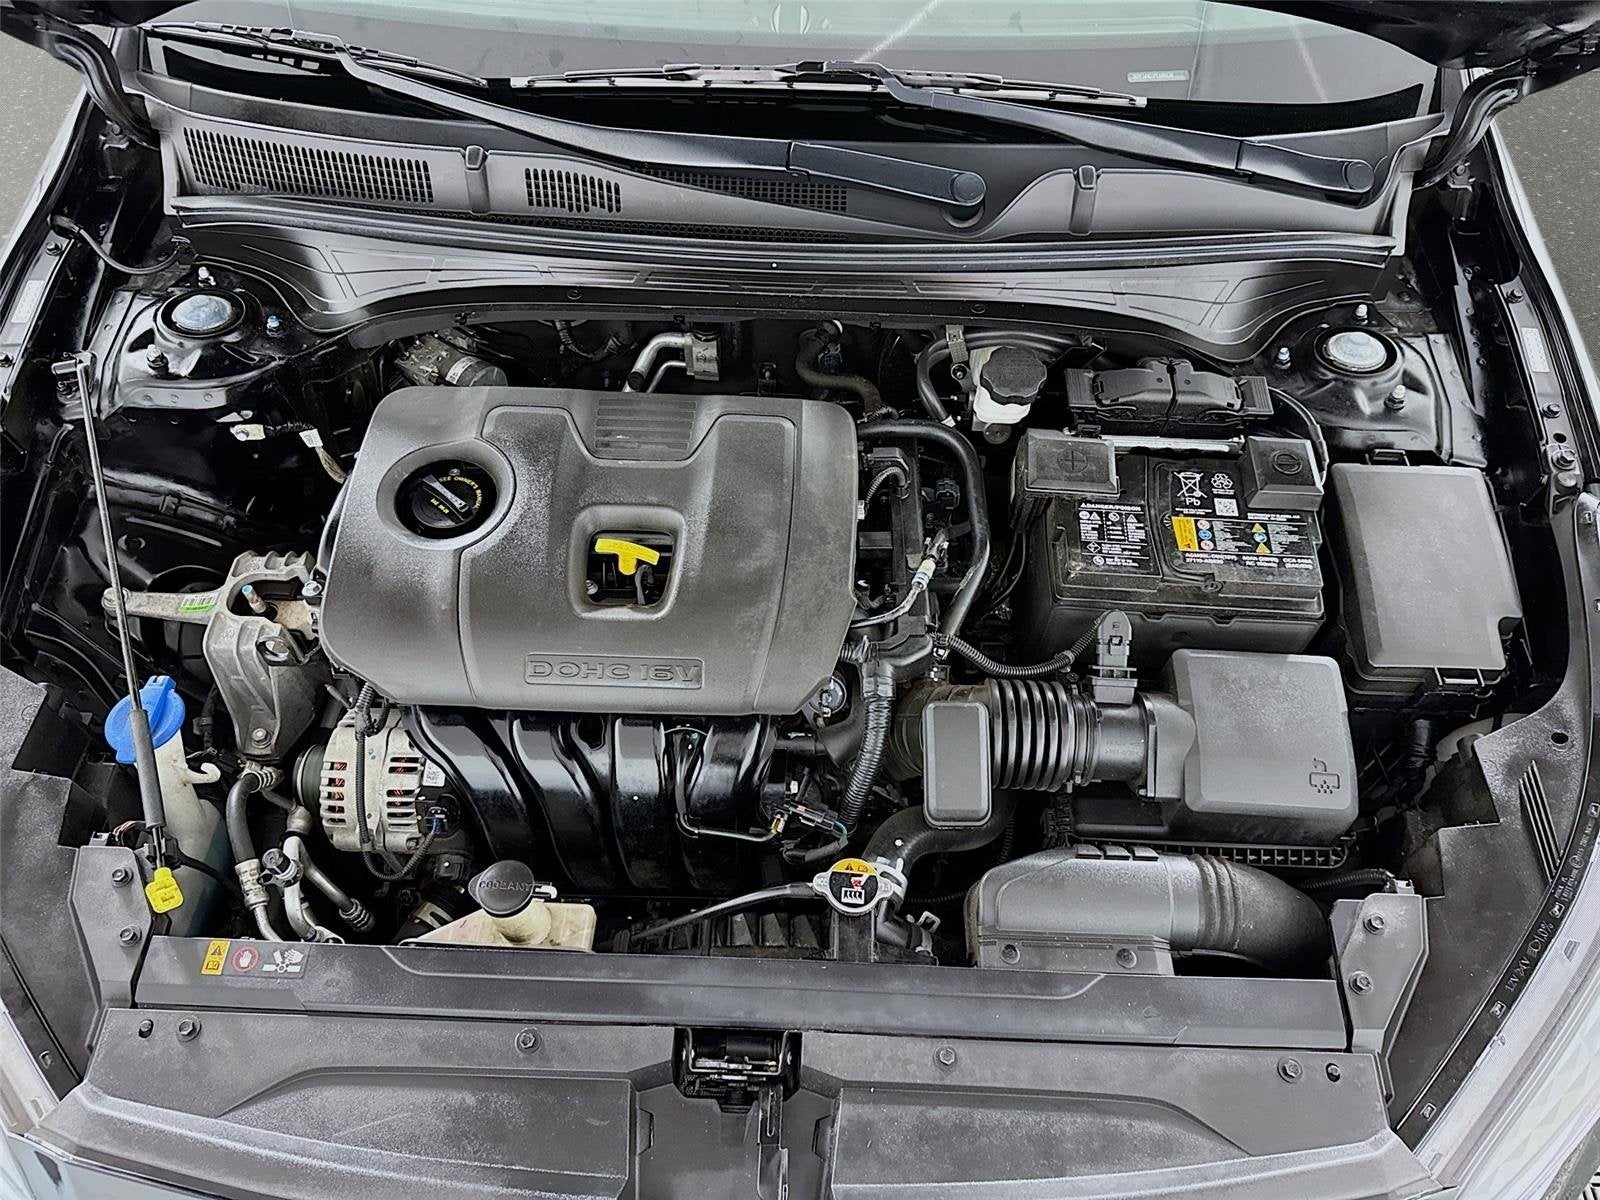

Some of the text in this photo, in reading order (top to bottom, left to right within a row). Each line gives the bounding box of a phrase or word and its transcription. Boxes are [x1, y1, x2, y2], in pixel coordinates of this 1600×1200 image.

[1185, 497, 1201, 506] Pb
[527, 660, 700, 683] DOHC 16V
[480, 880, 531, 891] COOLANT
[1505, 975, 1521, 992] 12V
